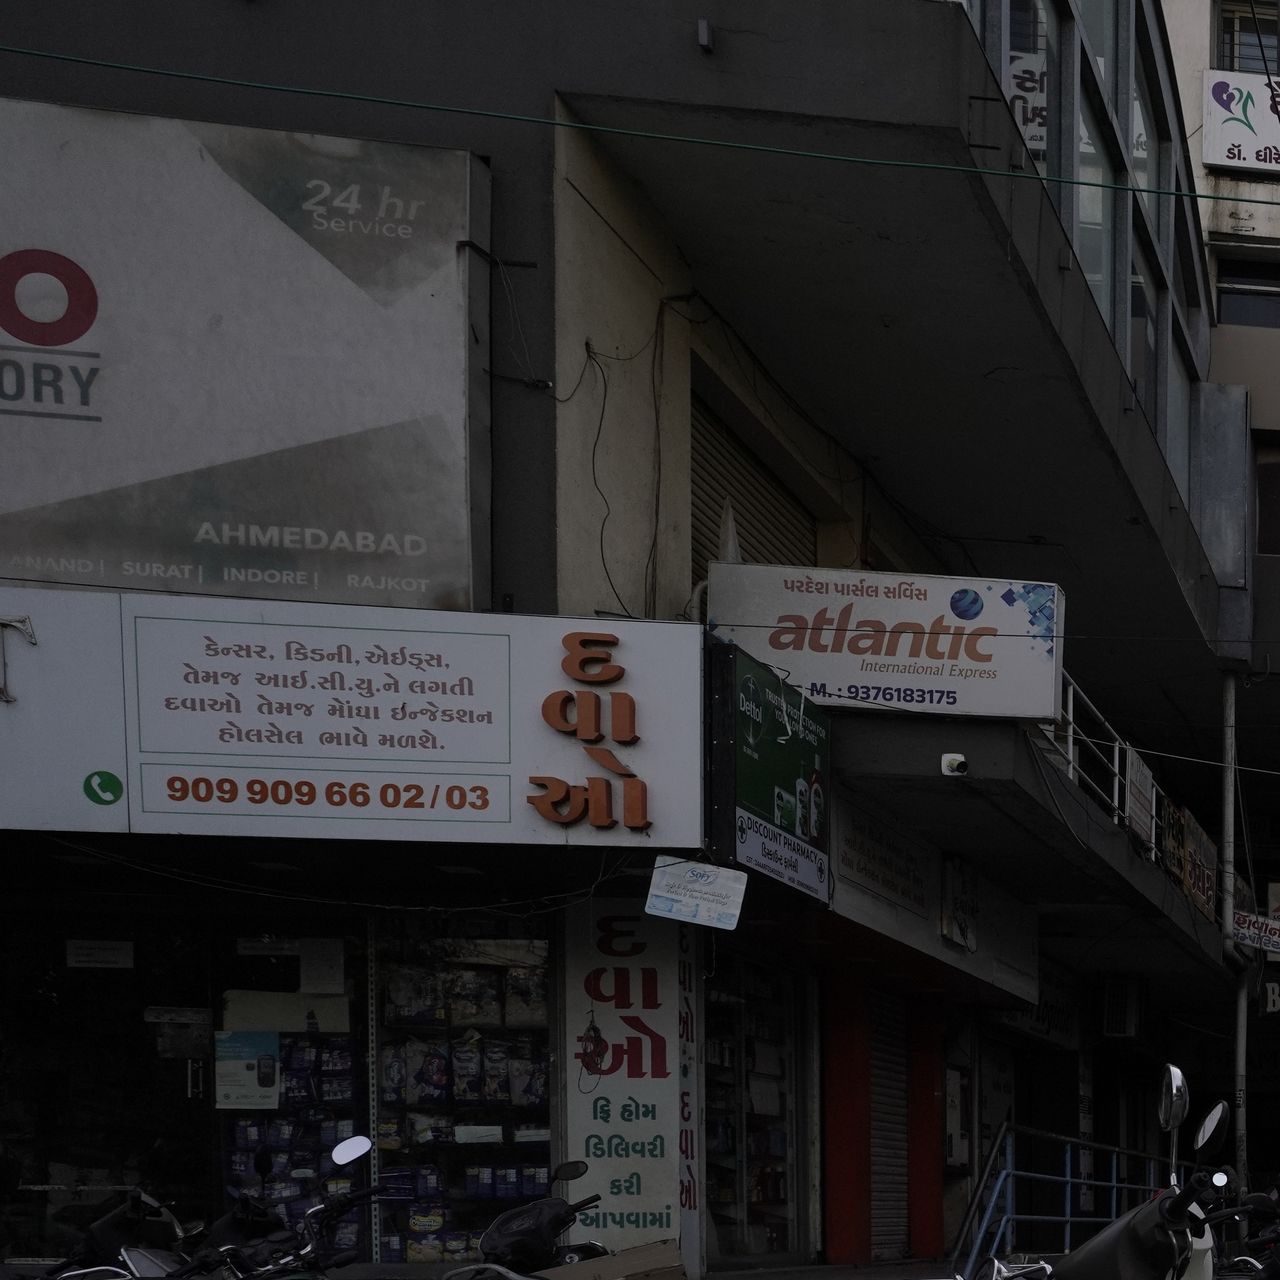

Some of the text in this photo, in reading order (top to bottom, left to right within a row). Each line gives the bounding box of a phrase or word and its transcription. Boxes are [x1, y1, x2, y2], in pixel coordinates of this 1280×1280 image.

[302, 180, 425, 220] 24 hr
[313, 211, 413, 239] Service
[195, 522, 427, 557] AHMEDABAD
[122, 562, 191, 579] SURAT
[223, 569, 307, 586] INDORE
[346, 574, 429, 593] RAJKOT
[783, 579, 928, 602] પરદેશ પાર્સલ સર્વિસ
[767, 603, 998, 662] atlantic
[860, 659, 997, 680] International Express
[740, 692, 762, 723] Dettol
[847, 685, 957, 705] 9376183175
[219, 721, 303, 744] હોલસેલ
[319, 726, 368, 747] ભાવે
[166, 776, 239, 803] 909
[246, 779, 317, 805] 909
[325, 781, 371, 807] 66
[747, 817, 781, 845] DISCOUNT
[784, 835, 818, 864] PHARMACY
[585, 1135, 664, 1158] ડિલિવરી
